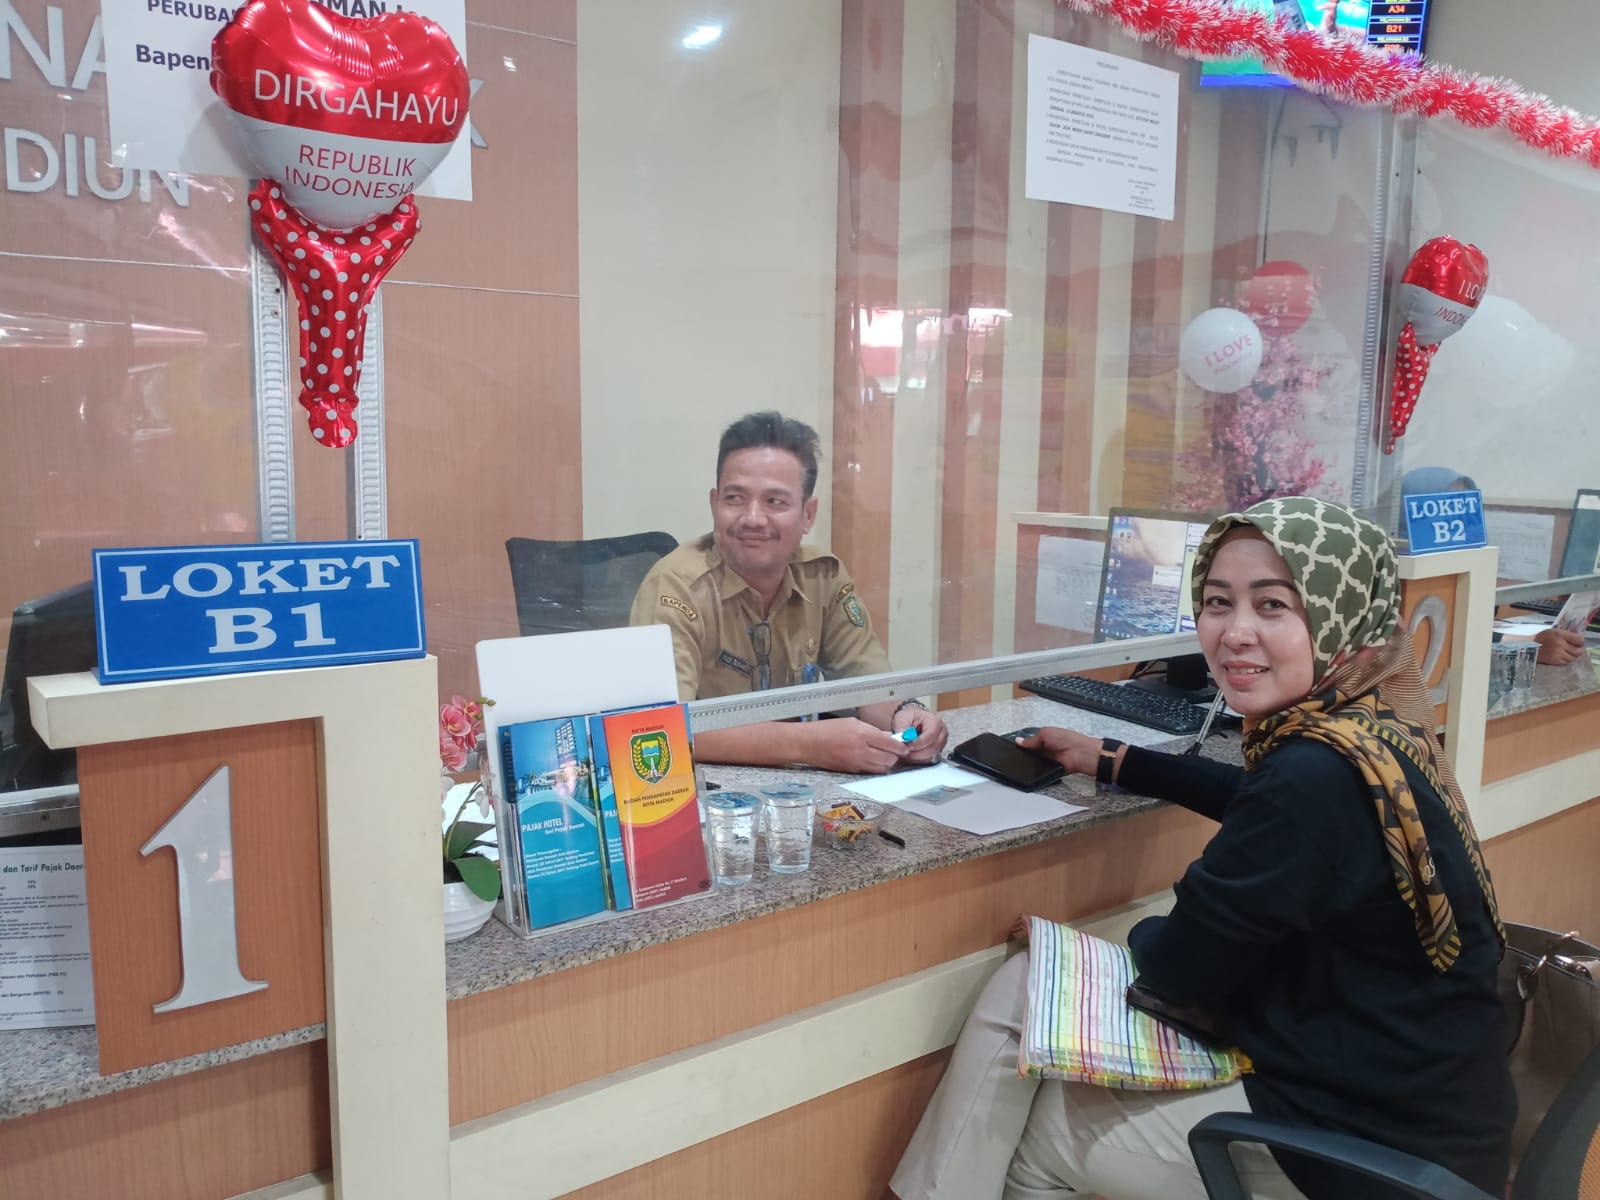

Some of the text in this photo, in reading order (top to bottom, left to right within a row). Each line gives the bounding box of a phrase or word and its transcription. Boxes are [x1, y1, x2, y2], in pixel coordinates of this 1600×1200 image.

[147, 0, 237, 22] PERUBA
[252, 67, 459, 127] DIRGAHAYU
[299, 144, 417, 177] REPUBLIK
[285, 165, 415, 199] INDONESIA
[1204, 354, 1213, 368] I
[1212, 334, 1253, 362] LOVE
[1410, 497, 1478, 519] LOKET
[1432, 520, 1466, 544] B2
[118, 554, 401, 602] LOKET
[3, 864, 18, 874] dan
[20, 863, 39, 873] Tarif
[41, 863, 63, 873] Pajak
[138, 762, 270, 1014] 1
